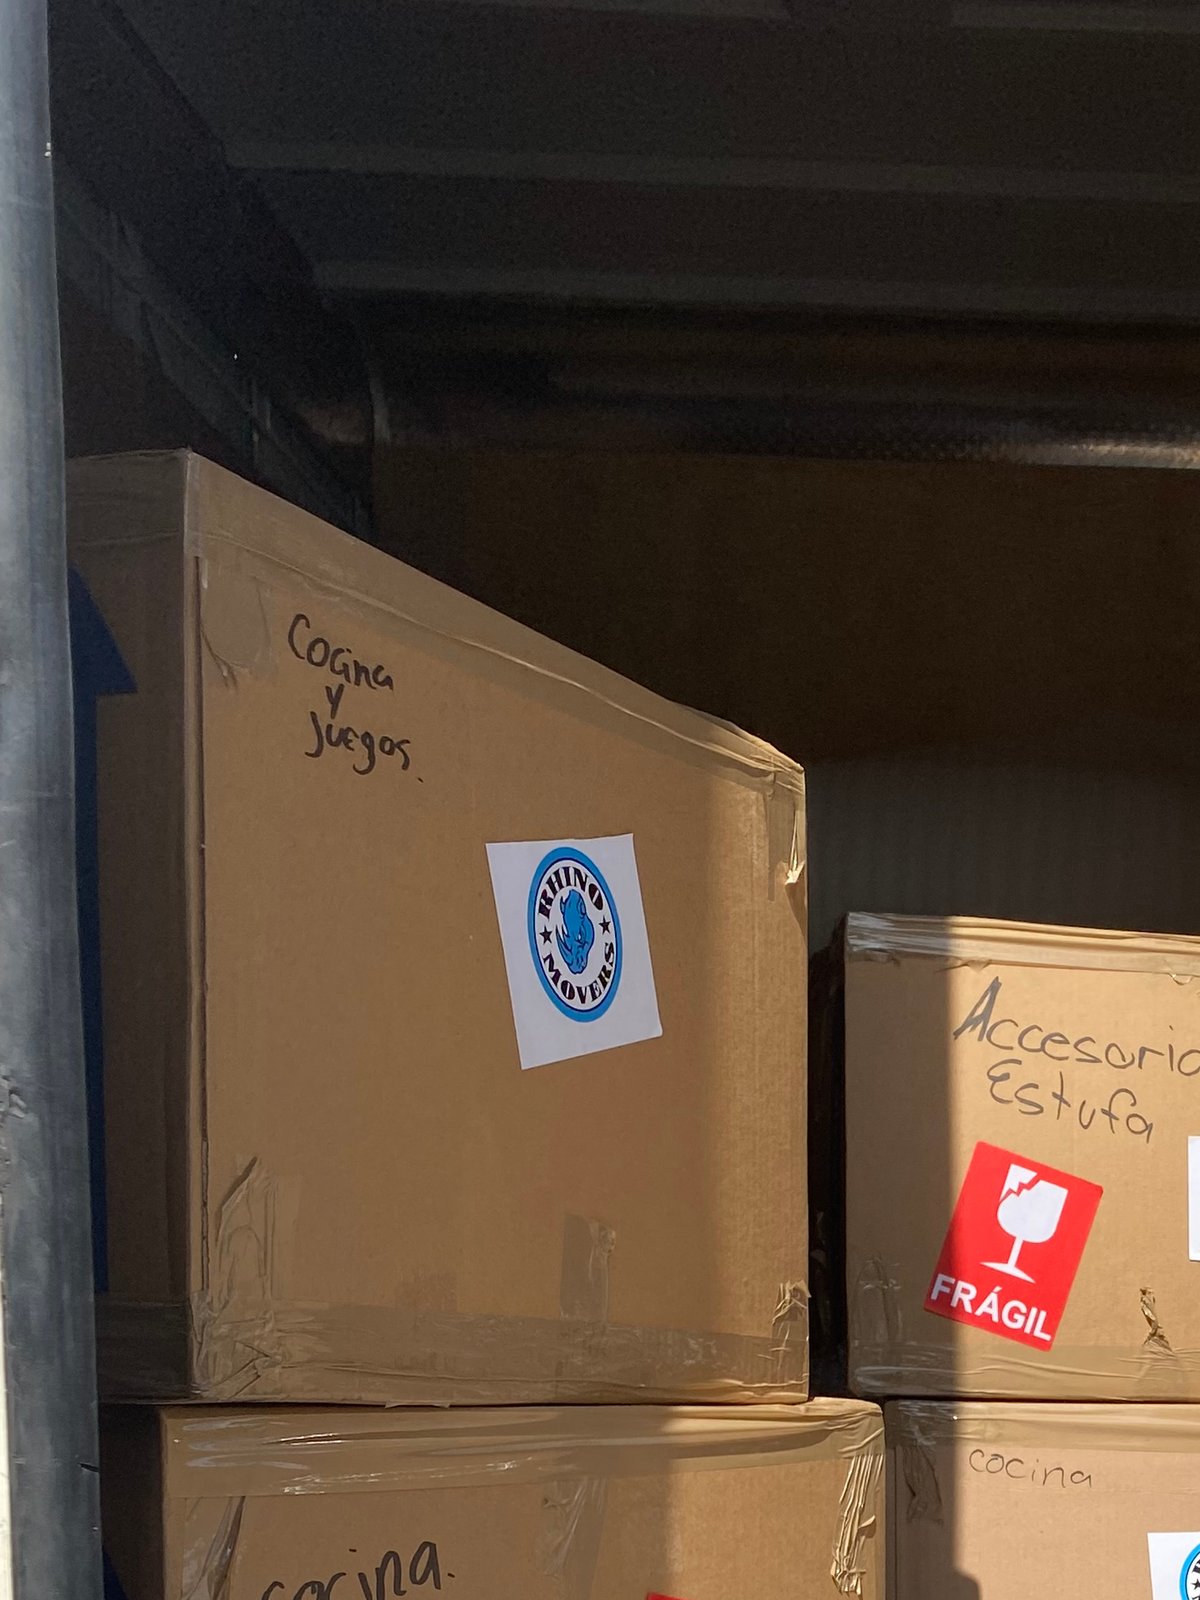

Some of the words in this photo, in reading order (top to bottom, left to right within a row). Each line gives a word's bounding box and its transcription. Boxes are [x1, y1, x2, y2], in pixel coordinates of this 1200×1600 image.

[538, 866, 604, 920] RHINO
[542, 942, 615, 1004] MOVERS
[987, 1058, 1153, 1144] Estufa
[930, 1273, 1052, 1342] FRÁGIL
[969, 1449, 1092, 1488] cocina
